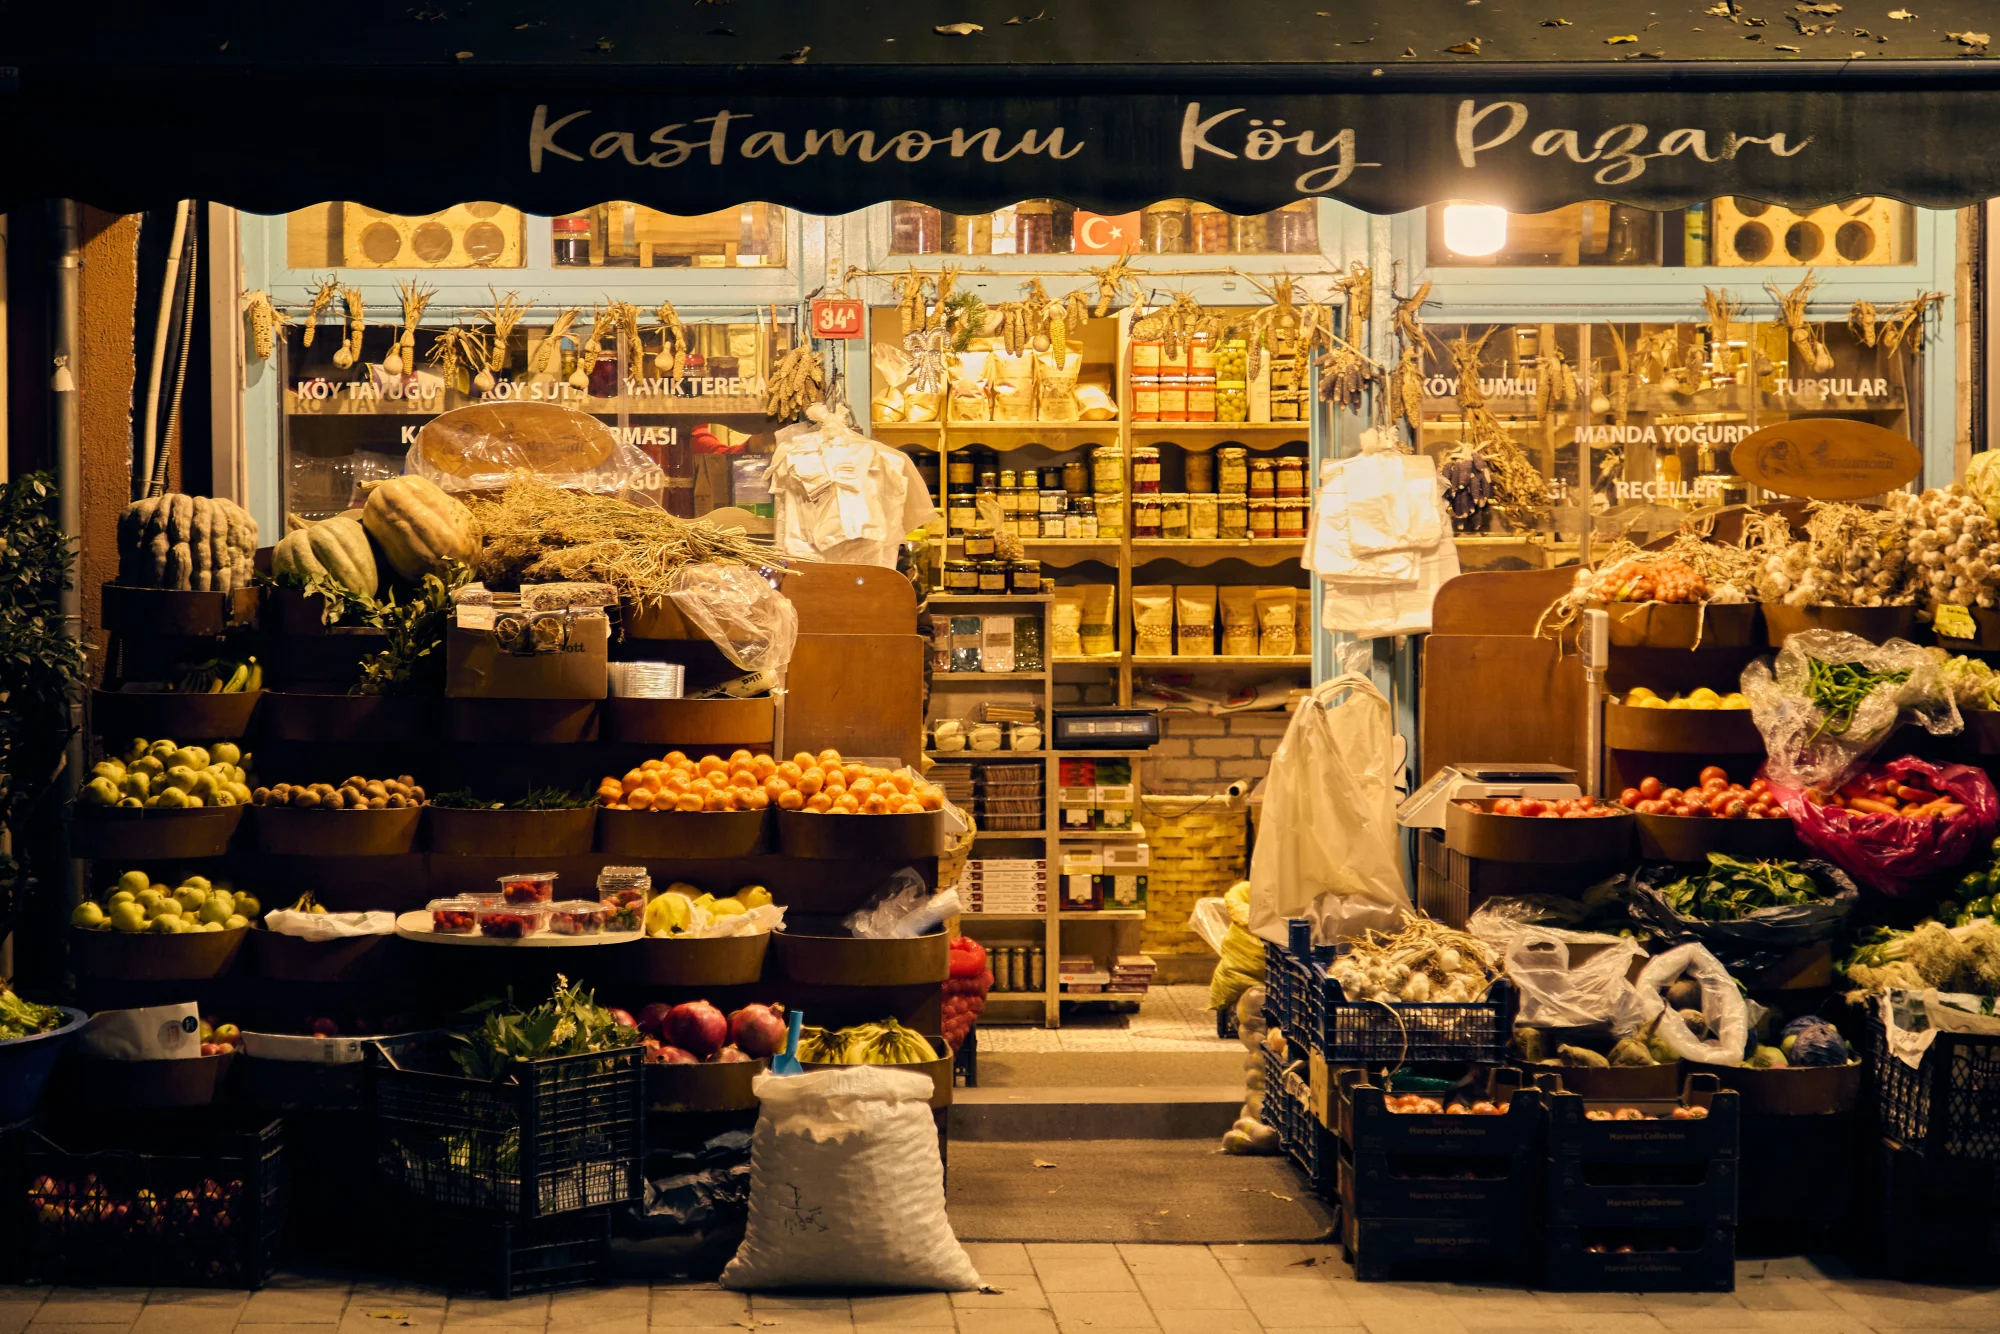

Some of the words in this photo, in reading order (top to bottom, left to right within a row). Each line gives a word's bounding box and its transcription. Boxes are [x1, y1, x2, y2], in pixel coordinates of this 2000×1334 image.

[528, 104, 1085, 173] Kastamonu
[1179, 101, 1382, 193] Köy
[297, 377, 342, 400] KÖY
[346, 377, 437, 400] TAVUĞU
[623, 377, 684, 396] YAYIK
[1775, 378, 1887, 400] TURŞULAR
[1575, 425, 1656, 444] MANDA
[1661, 422, 1760, 444] YOĞURD
[1616, 481, 1720, 502] REÇELLER
[1408, 1127, 1442, 1137] Harvest
[1444, 1127, 1486, 1137] Collection
[1608, 1132, 1642, 1141] Harvest
[1644, 1132, 1686, 1141] Collection
